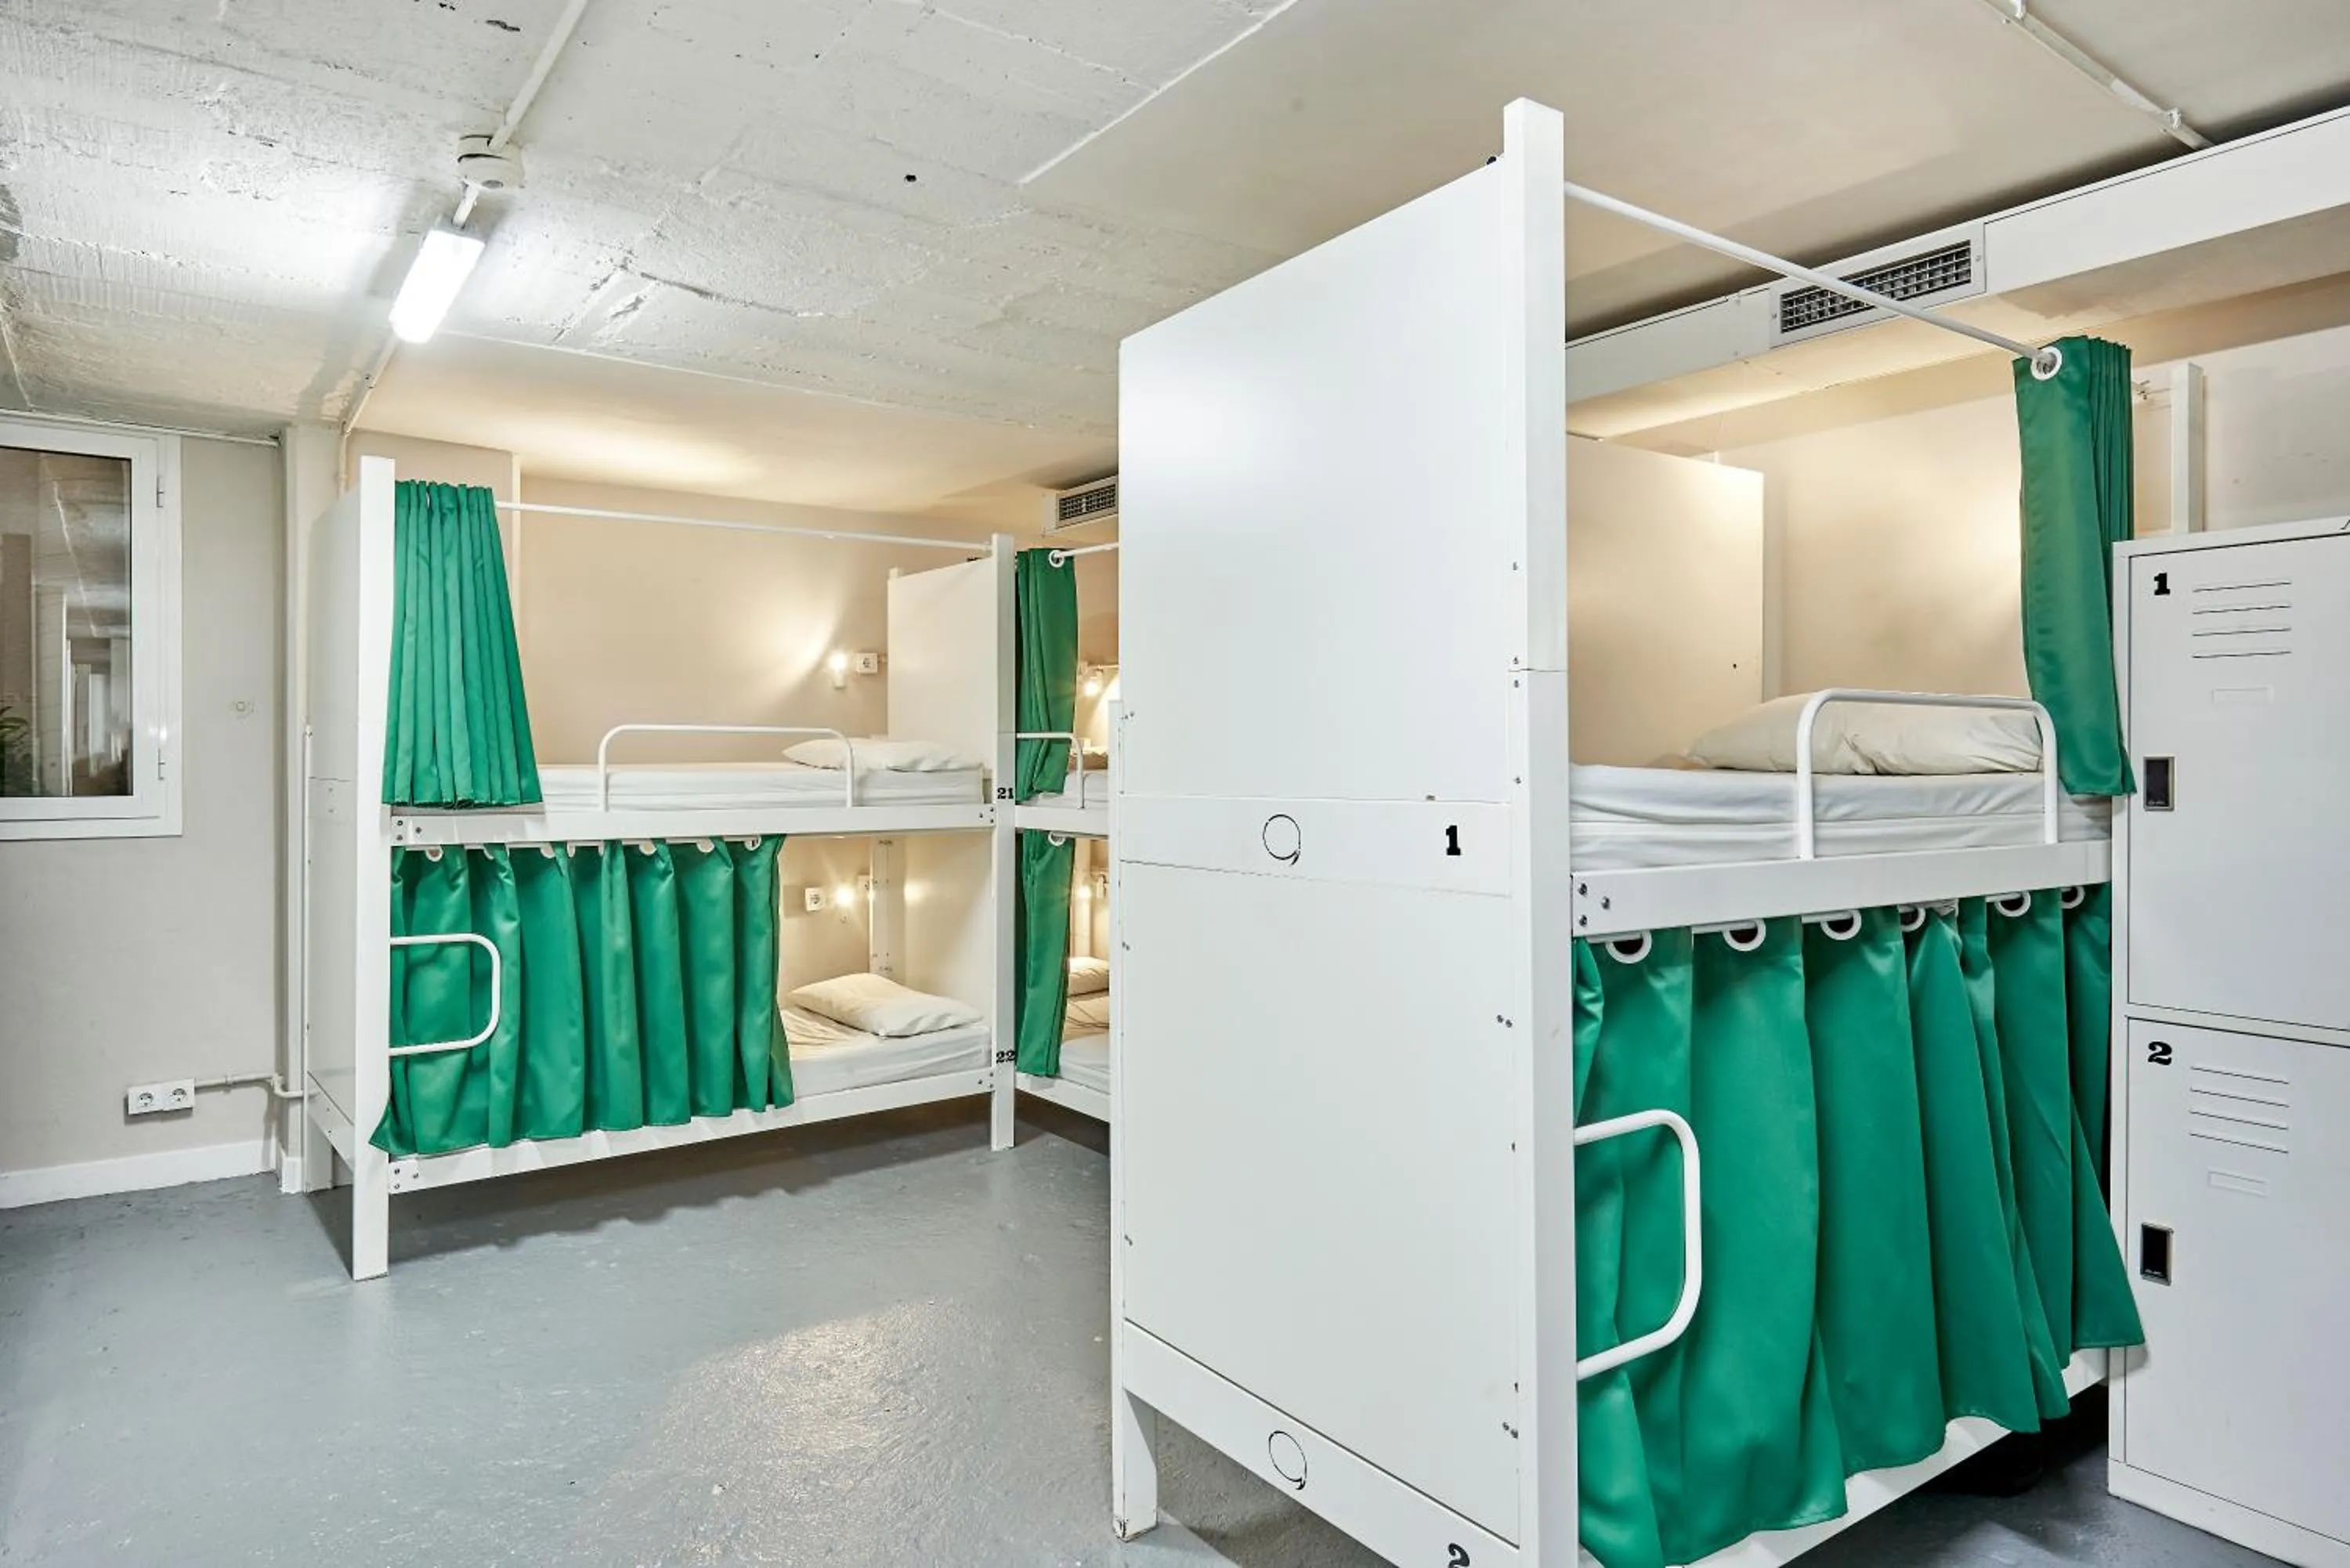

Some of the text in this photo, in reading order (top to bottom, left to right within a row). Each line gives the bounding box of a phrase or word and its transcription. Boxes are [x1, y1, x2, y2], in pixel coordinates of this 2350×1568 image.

[2153, 572, 2171, 596] 1
[997, 787, 1014, 800] 21
[1445, 825, 1462, 856] 1
[996, 1050, 1016, 1064] 22
[2147, 1041, 2173, 1066] 2
